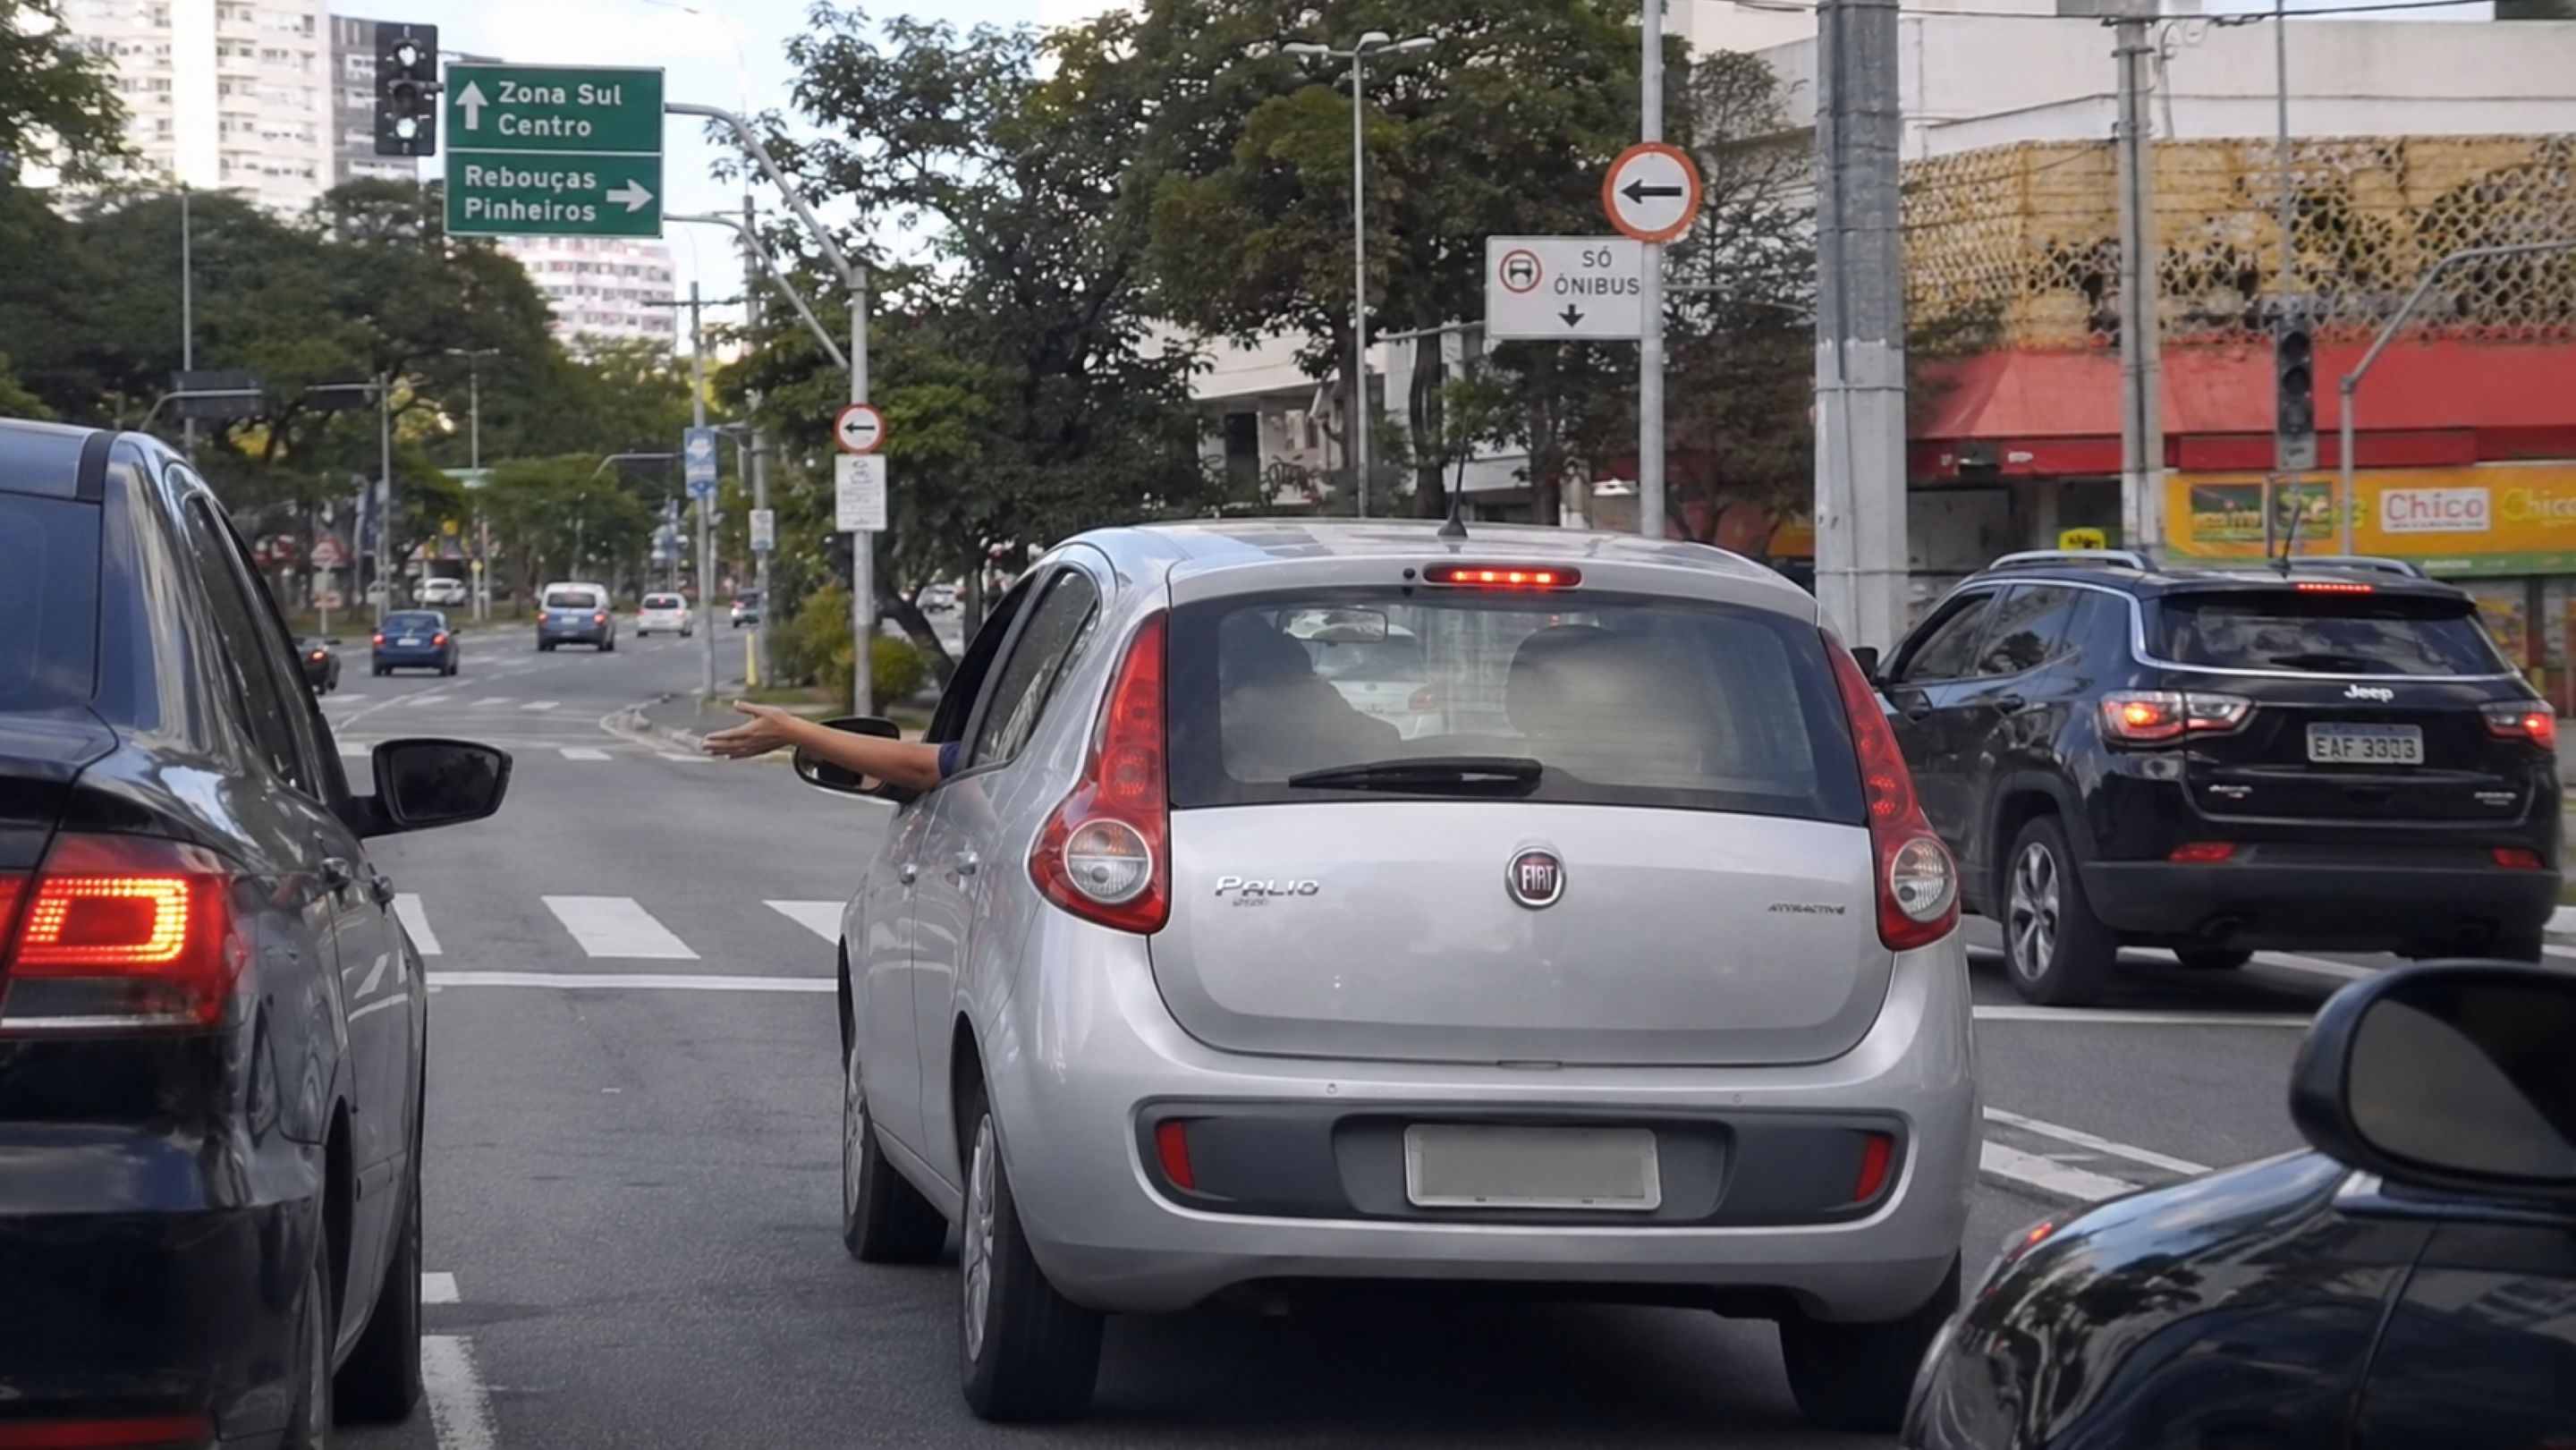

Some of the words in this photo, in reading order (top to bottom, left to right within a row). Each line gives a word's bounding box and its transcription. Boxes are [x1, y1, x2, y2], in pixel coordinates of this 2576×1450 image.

[498, 81, 565, 104] Zona
[578, 83, 622, 106] Sul
[498, 114, 592, 137] Centro
[464, 165, 597, 194] Rebouças
[464, 198, 597, 222] Pinheiros
[1581, 245, 1613, 268] SÓ
[2386, 492, 2485, 521] Chico
[2343, 683, 2394, 703] Jeep
[2315, 737, 2354, 759] EAF
[1521, 864, 1555, 892] FIAT
